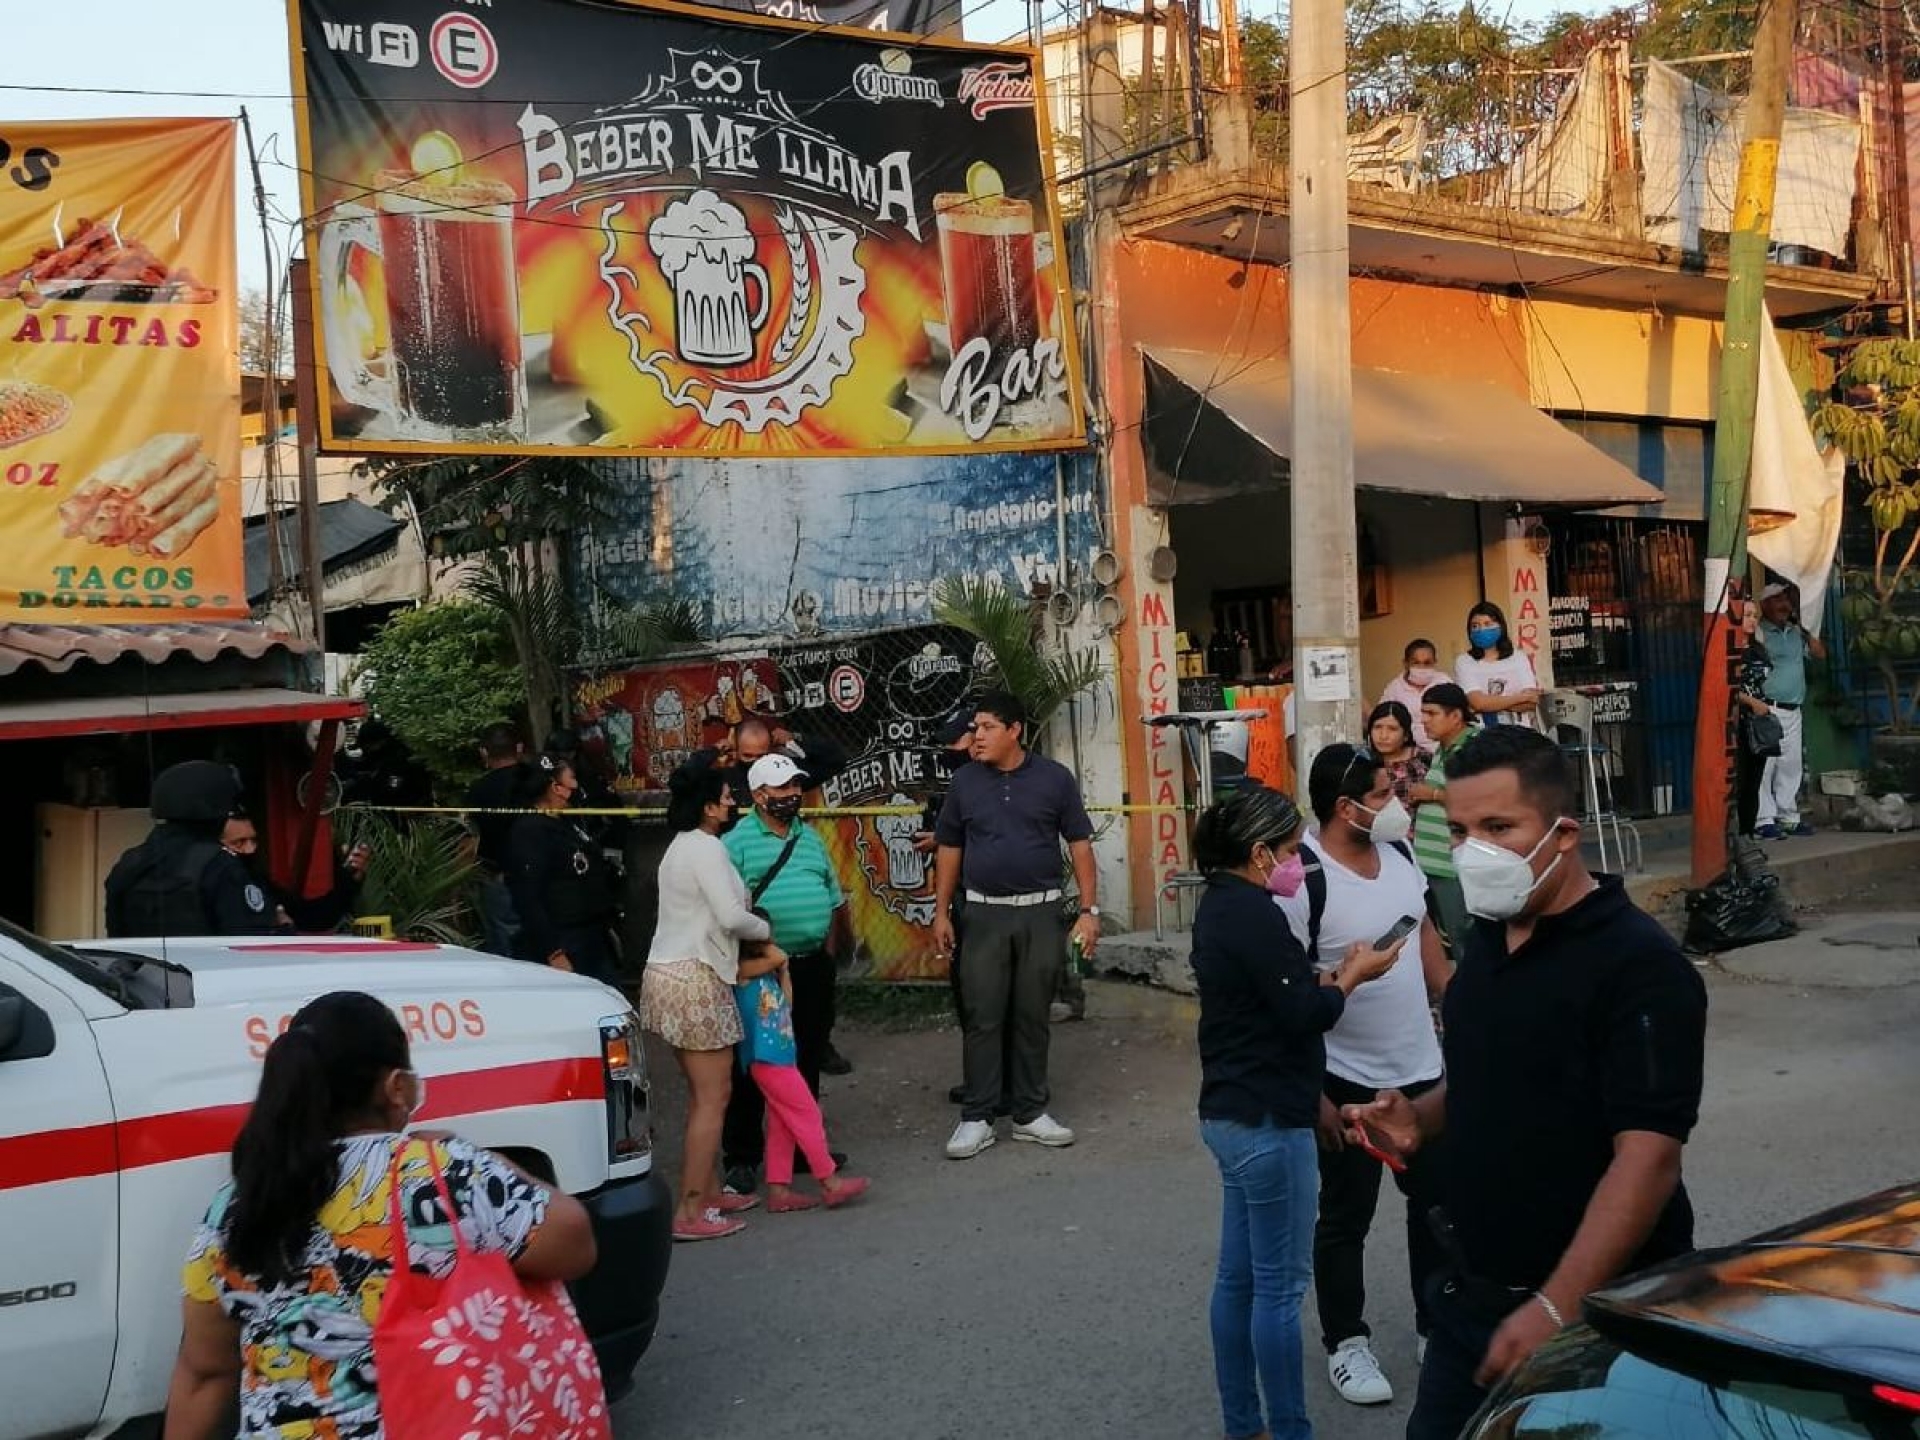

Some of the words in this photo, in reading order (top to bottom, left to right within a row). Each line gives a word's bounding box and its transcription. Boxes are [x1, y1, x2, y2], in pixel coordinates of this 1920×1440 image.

[449, 28, 479, 71] E
[853, 64, 944, 108] Corona
[958, 62, 1035, 120] Victori
[517, 102, 674, 212] BEBER
[686, 113, 759, 179] ME
[777, 127, 922, 242] LLAMA
[12, 314, 202, 348] ALITAS
[940, 337, 1065, 440] Bar
[52, 565, 194, 590] TACOS
[888, 751, 924, 788] ME
[245, 999, 486, 1059] SROS
